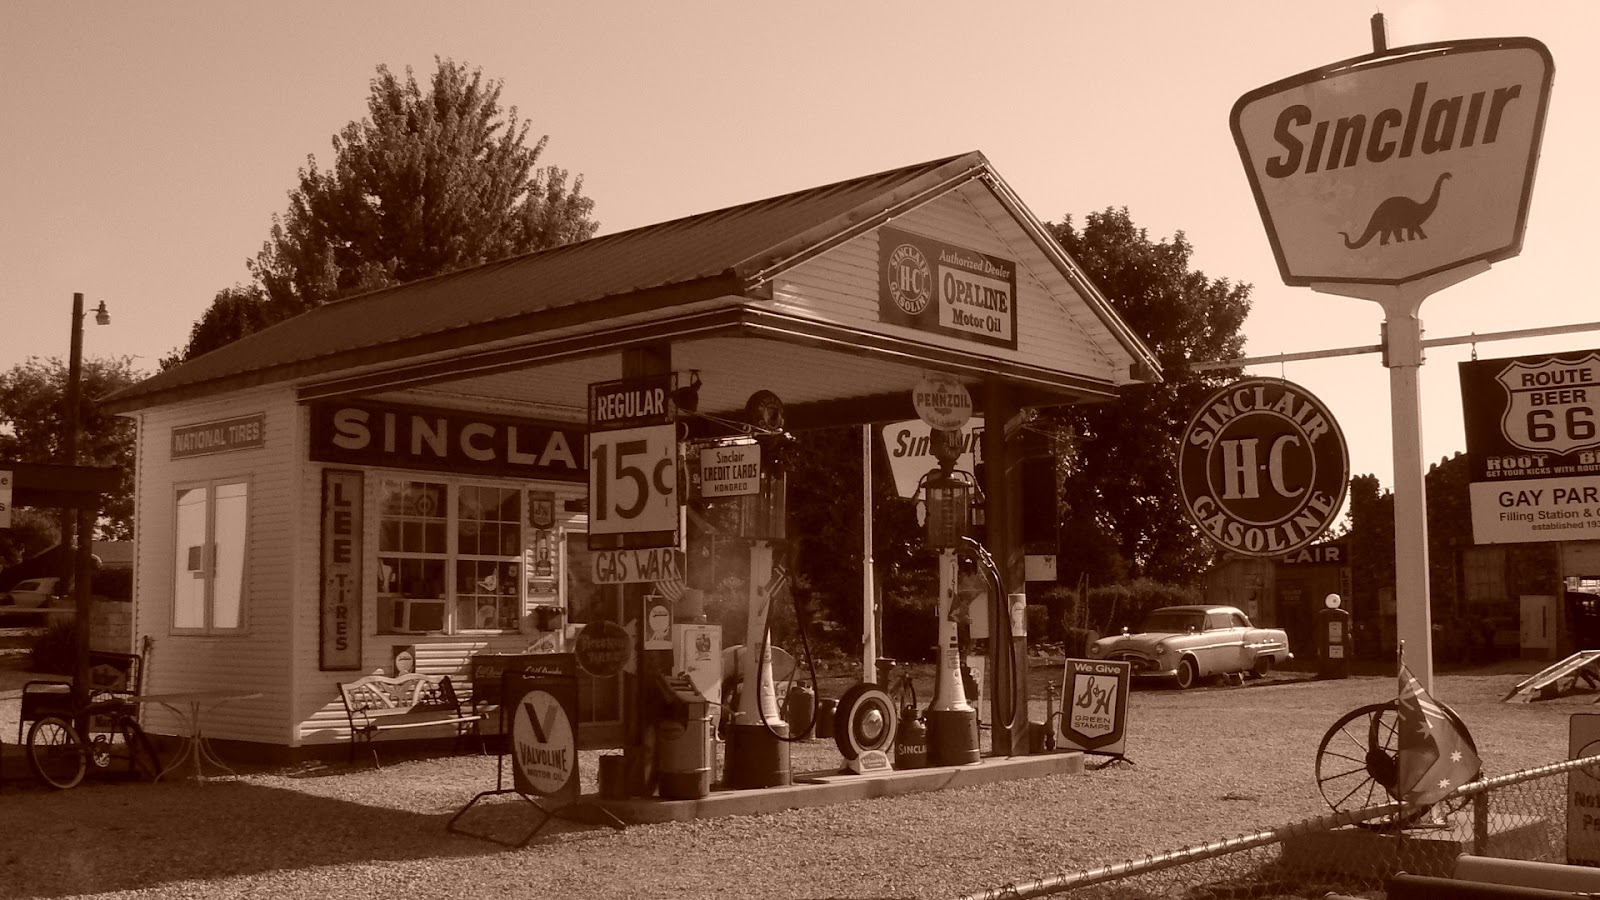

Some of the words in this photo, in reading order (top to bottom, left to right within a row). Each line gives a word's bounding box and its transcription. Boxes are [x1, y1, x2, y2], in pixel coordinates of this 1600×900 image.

[1265, 82, 1522, 178] Sinclair
[891, 247, 929, 278] SINCLAIR
[939, 249, 983, 272] Authorized
[984, 260, 1010, 279] Dealer
[891, 281, 930, 312] GASOLINE
[944, 272, 1008, 314] OPALINE
[952, 308, 985, 329] Motor
[986, 316, 1002, 333] Oil
[1521, 368, 1593, 387] ROUTE
[597, 388, 665, 421] REGULAR
[916, 392, 971, 409] PENNZOIL
[1530, 389, 1587, 407] BEER
[1190, 387, 1329, 450] SINCLAIR
[1526, 406, 1596, 443] 66
[175, 429, 227, 452] NATIONAL
[229, 422, 260, 444] TIRES
[332, 408, 588, 470] SINCLA
[716, 451, 745, 464] Sinclair
[1486, 454, 1549, 471] ROOT
[704, 466, 731, 482] CREDIT
[733, 464, 757, 480] CARDS
[1503, 469, 1524, 477] YOUR
[1526, 467, 1551, 476] KICKS
[1553, 466, 1575, 474] WITH
[714, 482, 748, 492] HONORED
[1498, 489, 1543, 508] GAY
[334, 482, 352, 564] LEE
[1193, 491, 1335, 552] GASOLINE
[1499, 511, 1534, 523] Filling
[1538, 509, 1579, 520] Station
[1583, 508, 1595, 518] &
[1532, 521, 1584, 531] established
[596, 550, 628, 582] GAS
[634, 549, 673, 581] WAR
[335, 573, 349, 651] TIRES
[1074, 662, 1093, 672] We
[1095, 664, 1121, 674] Give
[1074, 715, 1111, 724] GREEN
[1074, 722, 1110, 731] STAMPS
[519, 741, 568, 773] VALVOLINE
[527, 768, 551, 780] MOTOR
[553, 771, 565, 782] OIL
